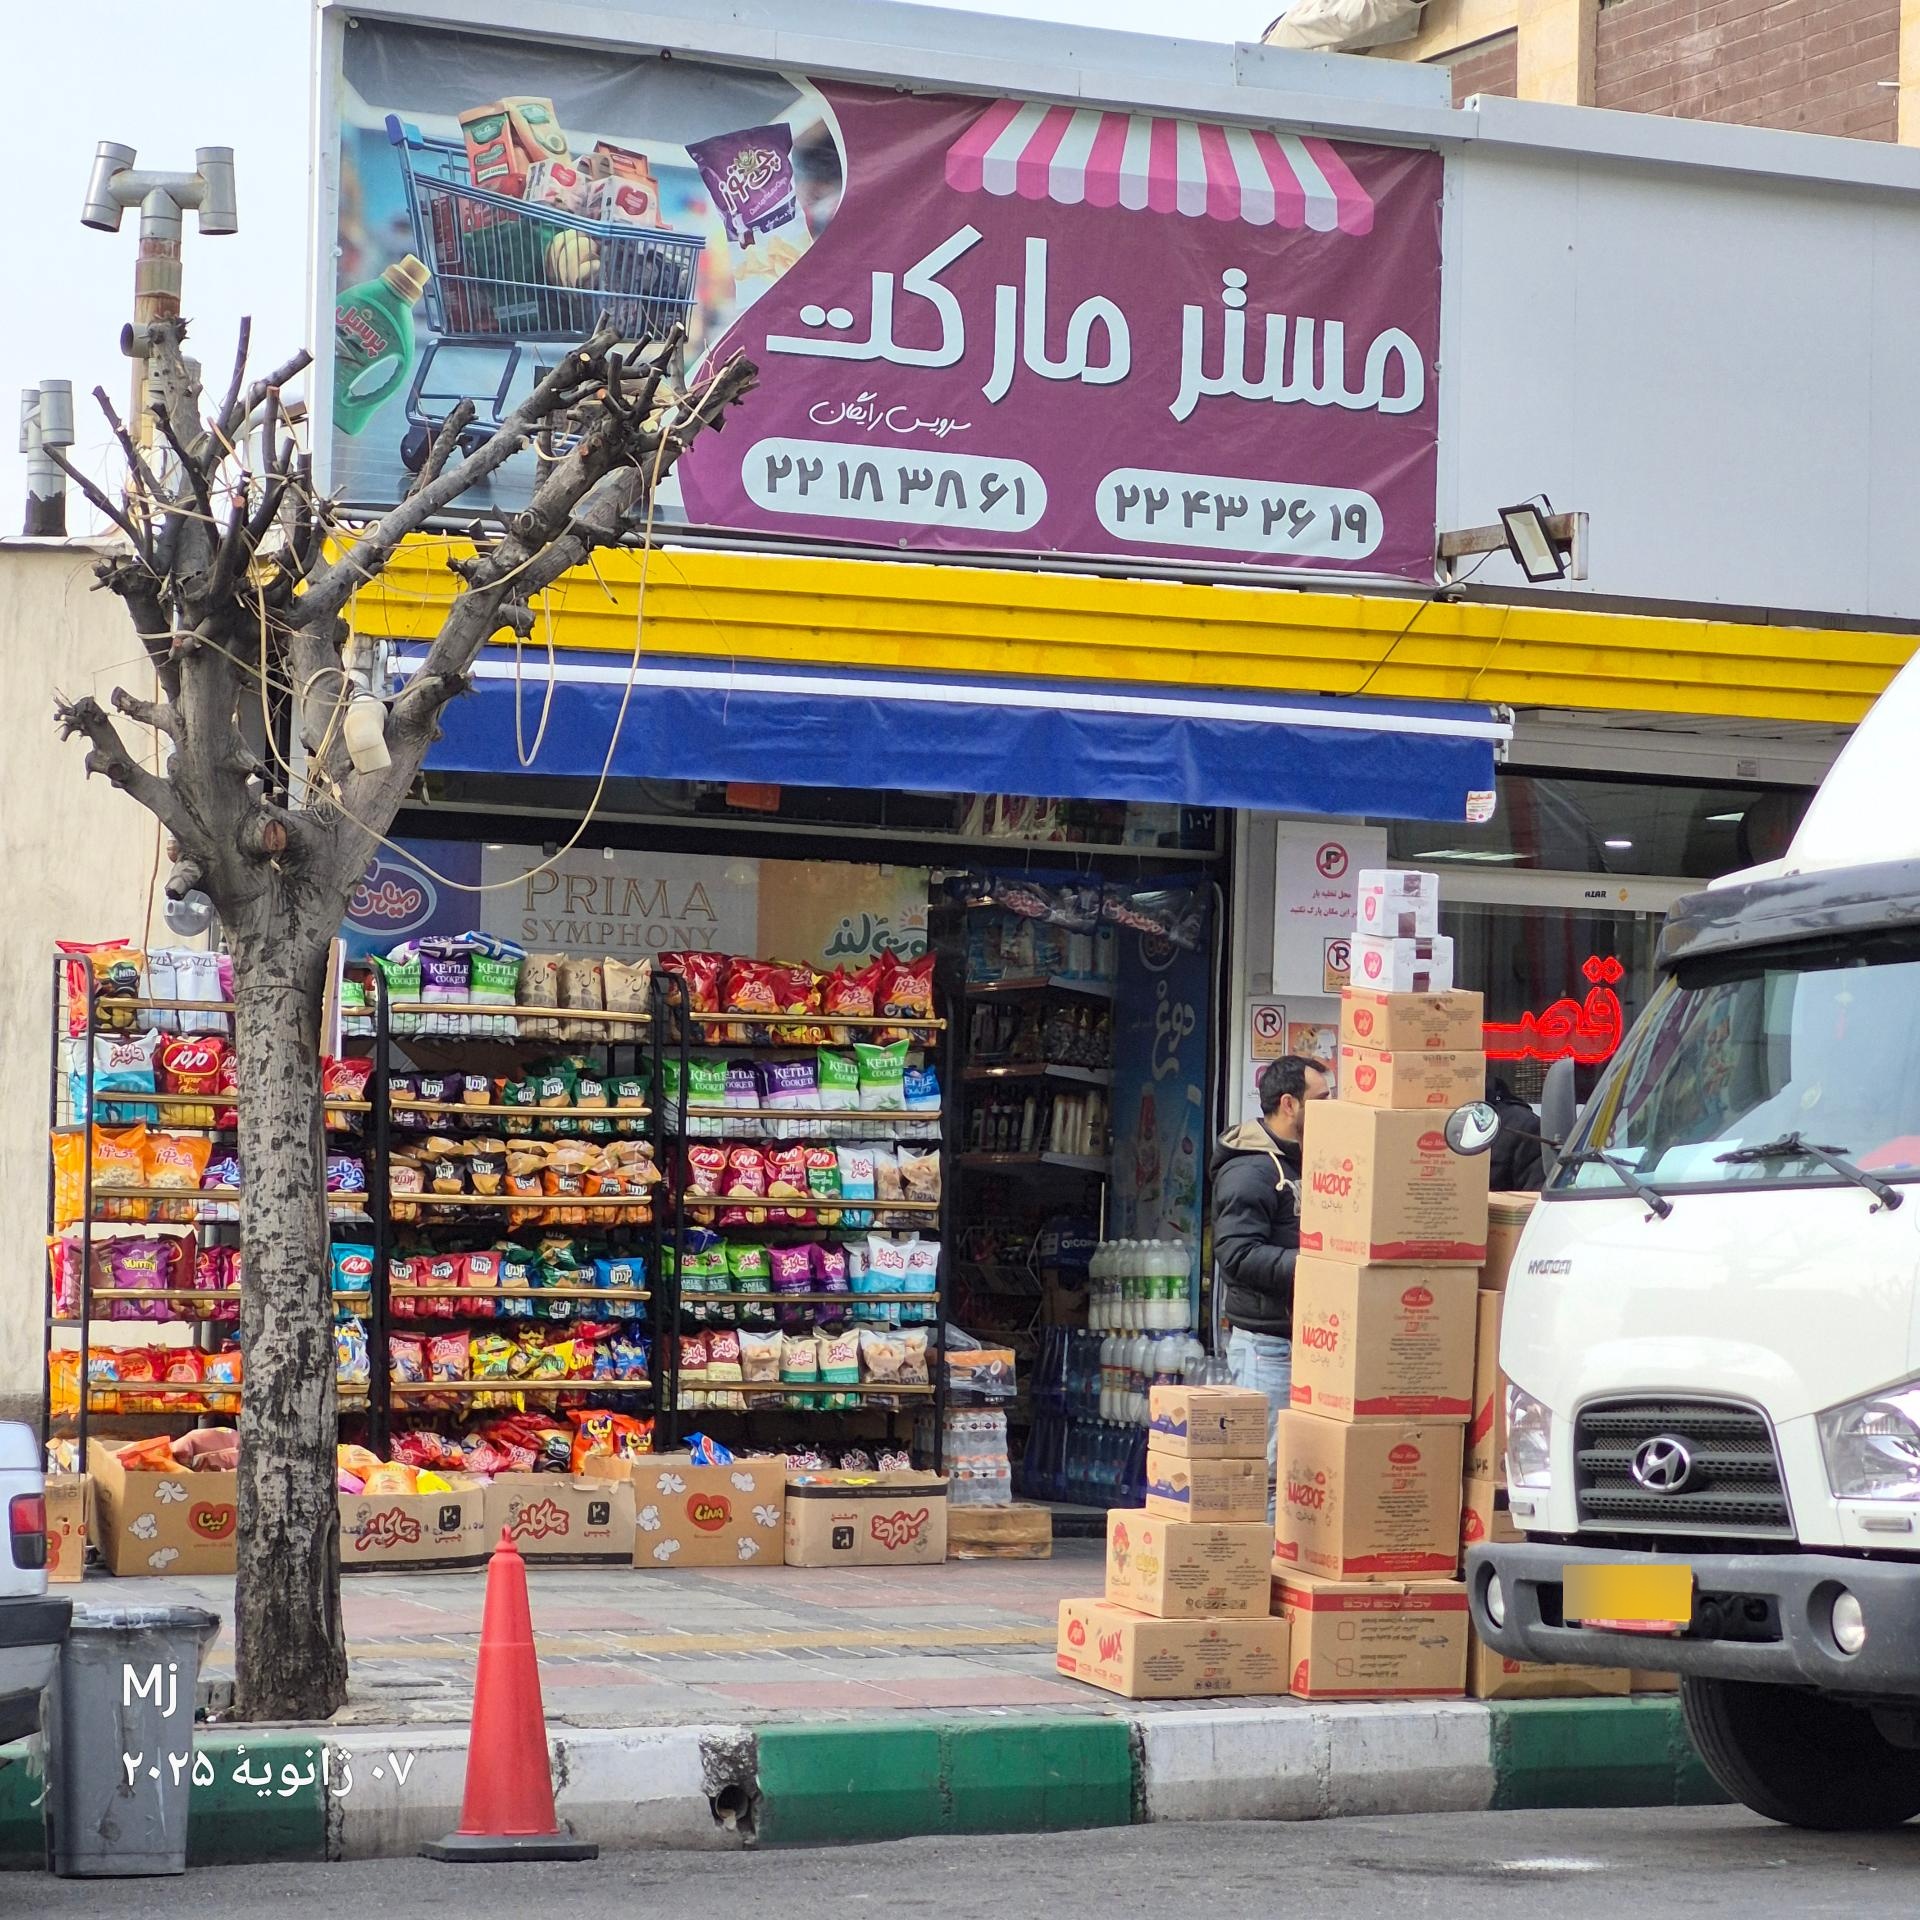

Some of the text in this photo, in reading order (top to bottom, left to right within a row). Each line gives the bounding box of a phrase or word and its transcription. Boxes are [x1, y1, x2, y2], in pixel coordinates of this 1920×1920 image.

[766, 223, 1425, 422] مستر مارکت
[809, 391, 972, 439] سرویس رایگان
[521, 867, 719, 922] PRIMA
[521, 918, 719, 950] SYMPHONY
[430, 963, 469, 975] KETTLE
[435, 975, 466, 985] COOKED
[478, 962, 519, 976] KETTLE
[171, 1046, 209, 1070] مزمز
[829, 1060, 858, 1074] KETTL
[774, 1066, 814, 1080] KETTLE
[834, 1073, 858, 1082] COOKE
[198, 1511, 229, 1532] لینا
[355, 1506, 420, 1551] چاکلز
[510, 1498, 570, 1541] چاکلز
